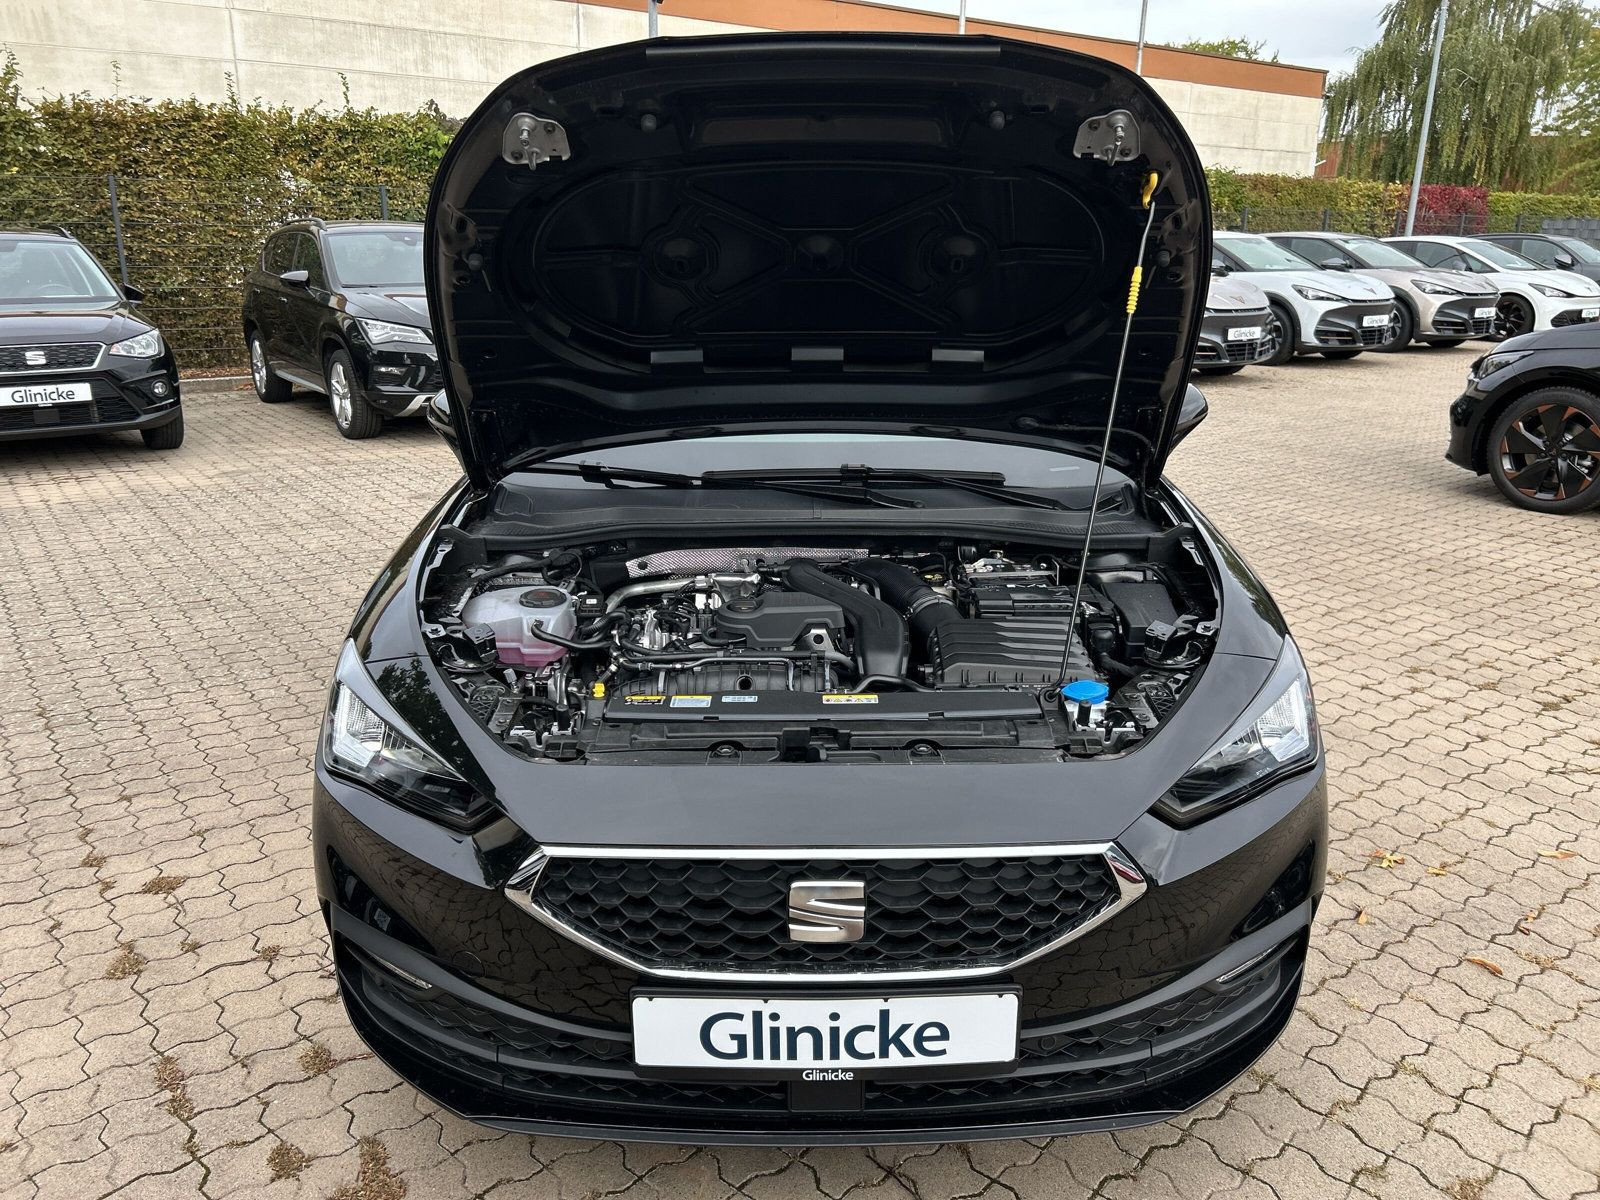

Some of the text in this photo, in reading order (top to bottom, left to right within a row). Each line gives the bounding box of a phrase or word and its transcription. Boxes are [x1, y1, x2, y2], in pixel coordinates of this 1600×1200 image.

[11, 387, 75, 403] Glinicke
[700, 1009, 950, 1061] Glinicke
[802, 1069, 854, 1081] Glinicke
